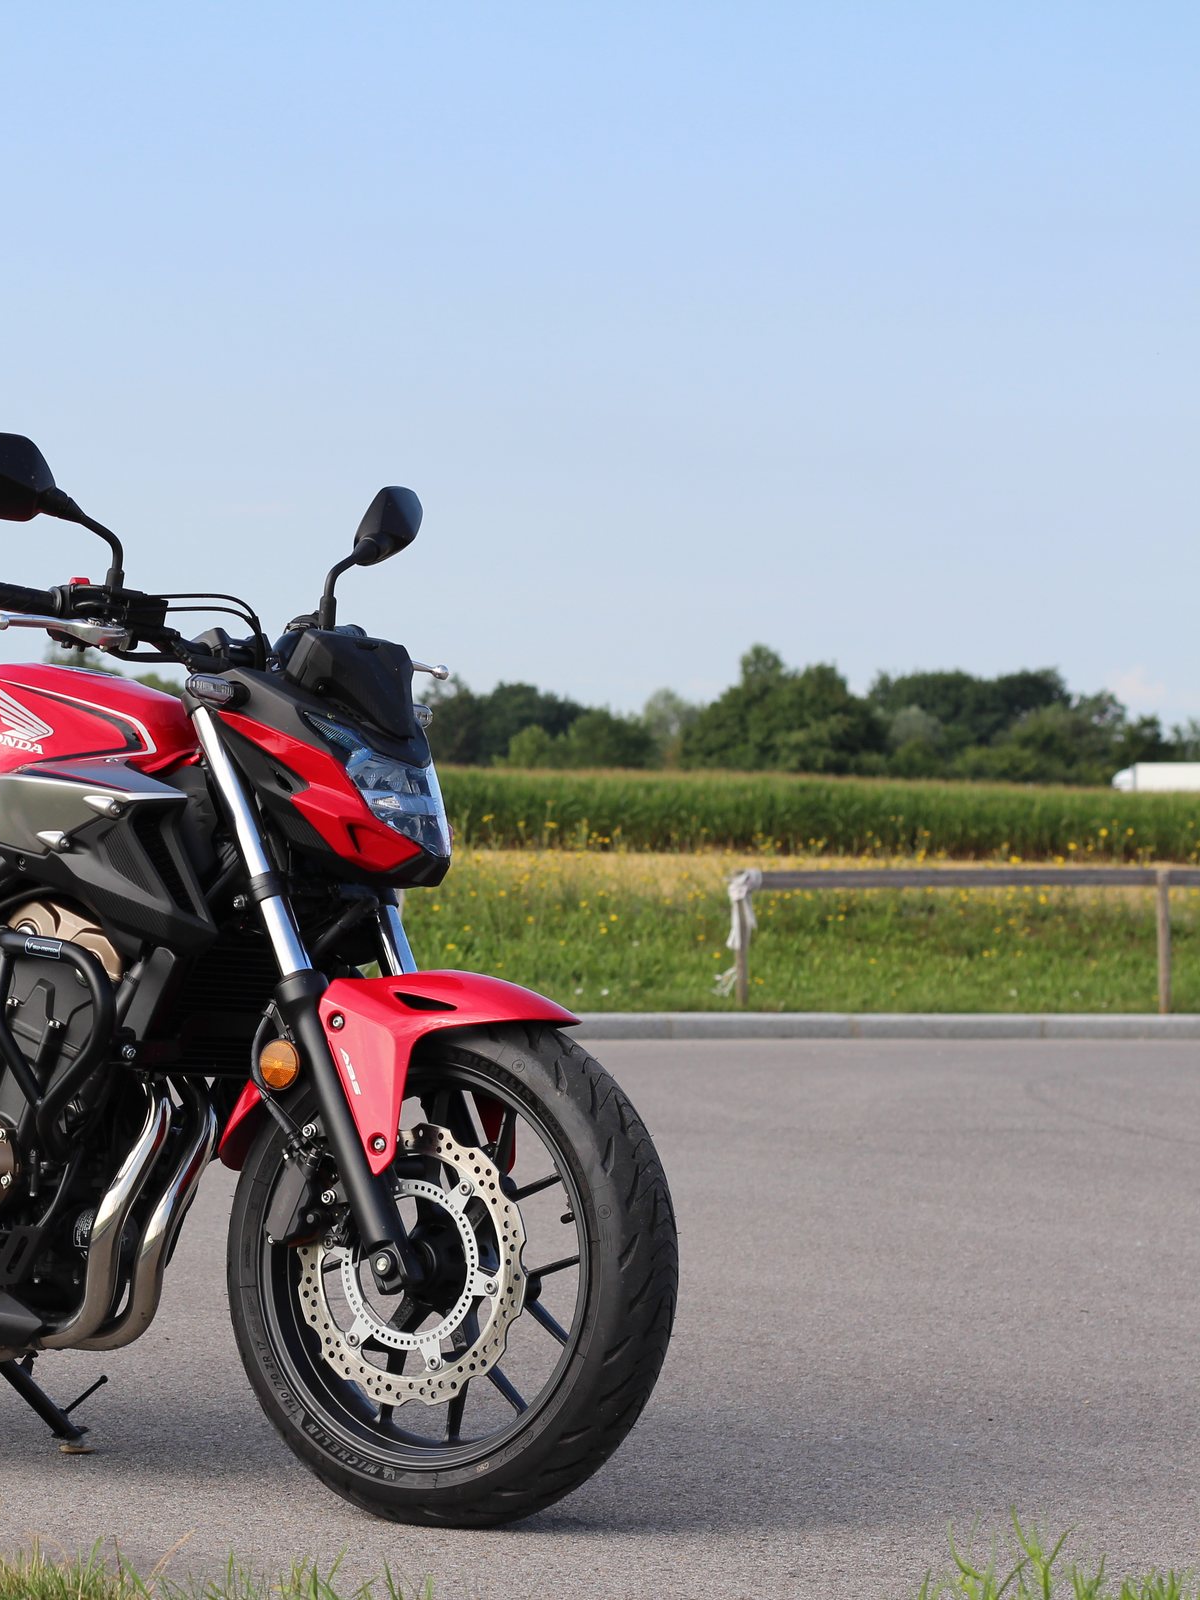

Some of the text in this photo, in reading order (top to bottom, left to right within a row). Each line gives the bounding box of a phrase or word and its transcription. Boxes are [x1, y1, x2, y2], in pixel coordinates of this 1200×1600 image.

[340, 1047, 362, 1096] ABS
[256, 1340, 296, 1409] 120/70 ZR 17
[305, 1422, 380, 1475] MICHELIN
